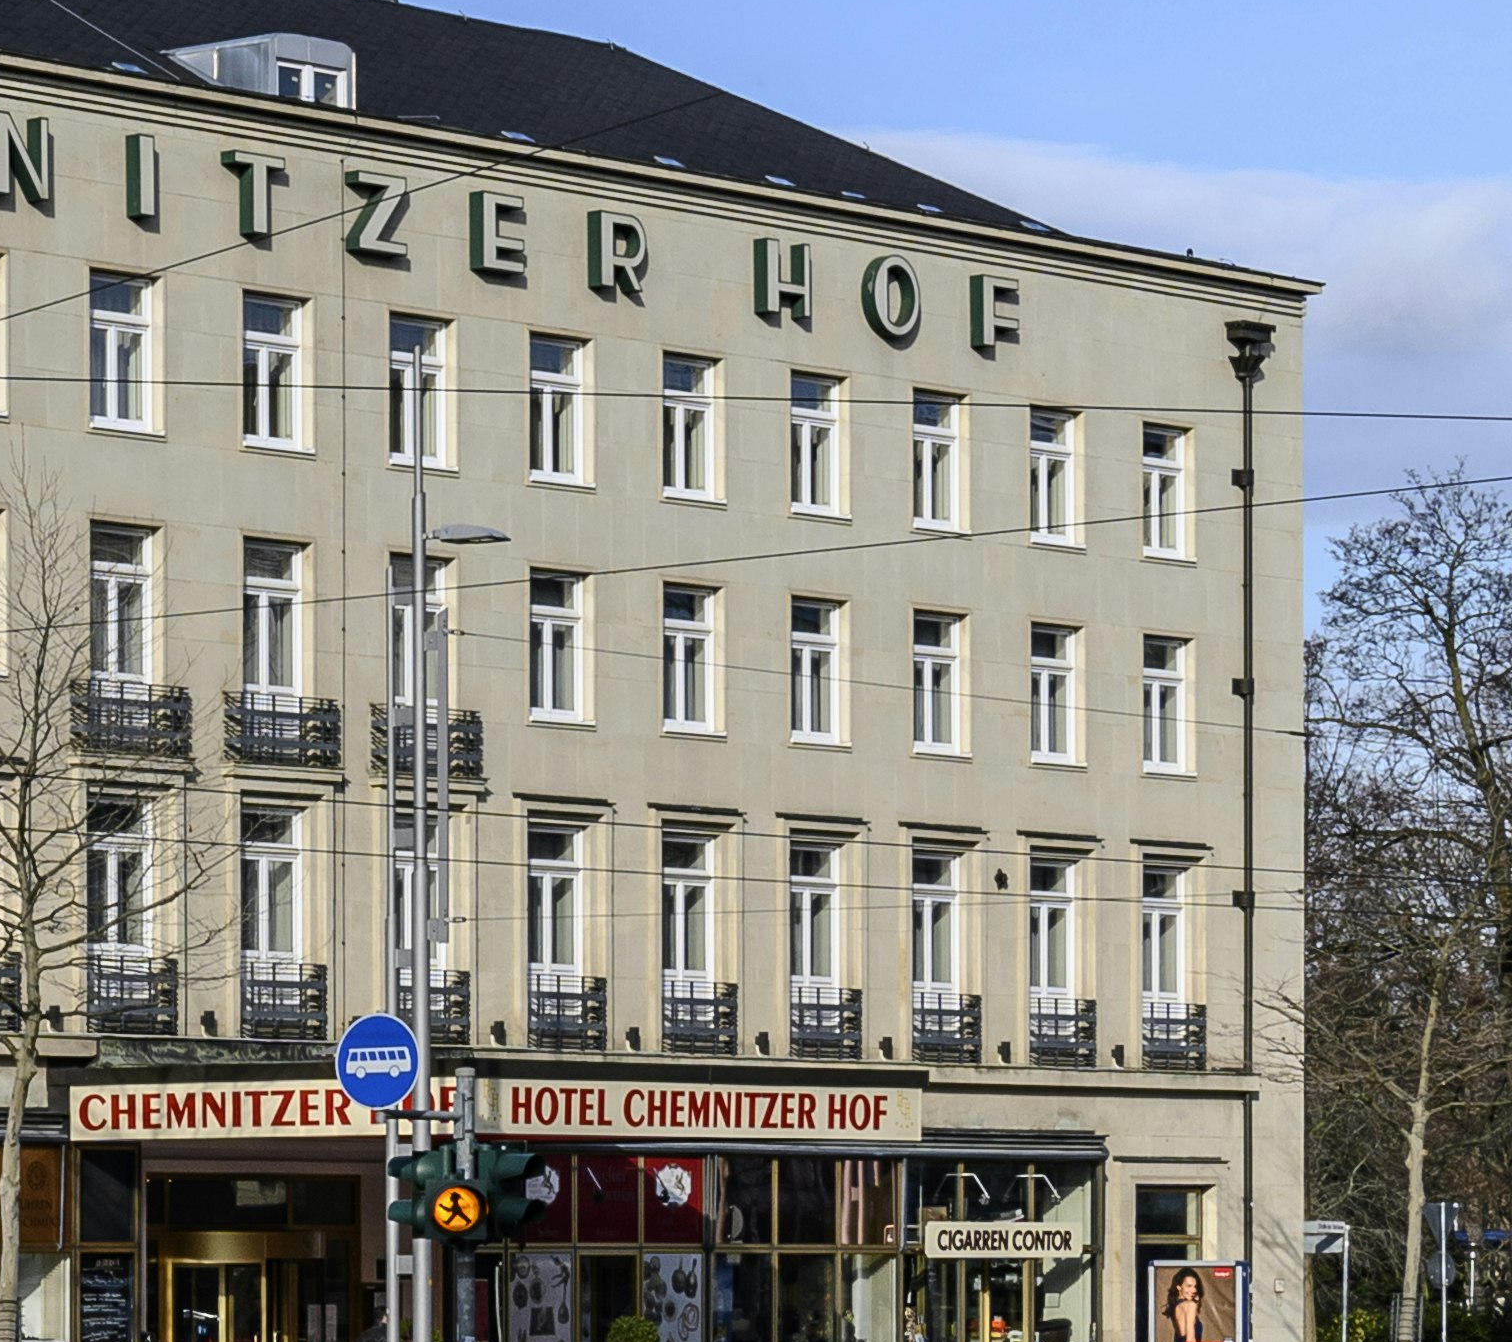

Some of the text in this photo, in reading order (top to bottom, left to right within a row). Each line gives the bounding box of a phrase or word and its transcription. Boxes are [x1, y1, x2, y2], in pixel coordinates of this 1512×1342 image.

[754, 236, 1021, 350] HOF
[79, 1089, 351, 1131] CHEMNITZER
[511, 1086, 888, 1130] HOTEL CHEMNITZER HOF
[937, 1229, 1072, 1251] CIGARREN CONTOR
